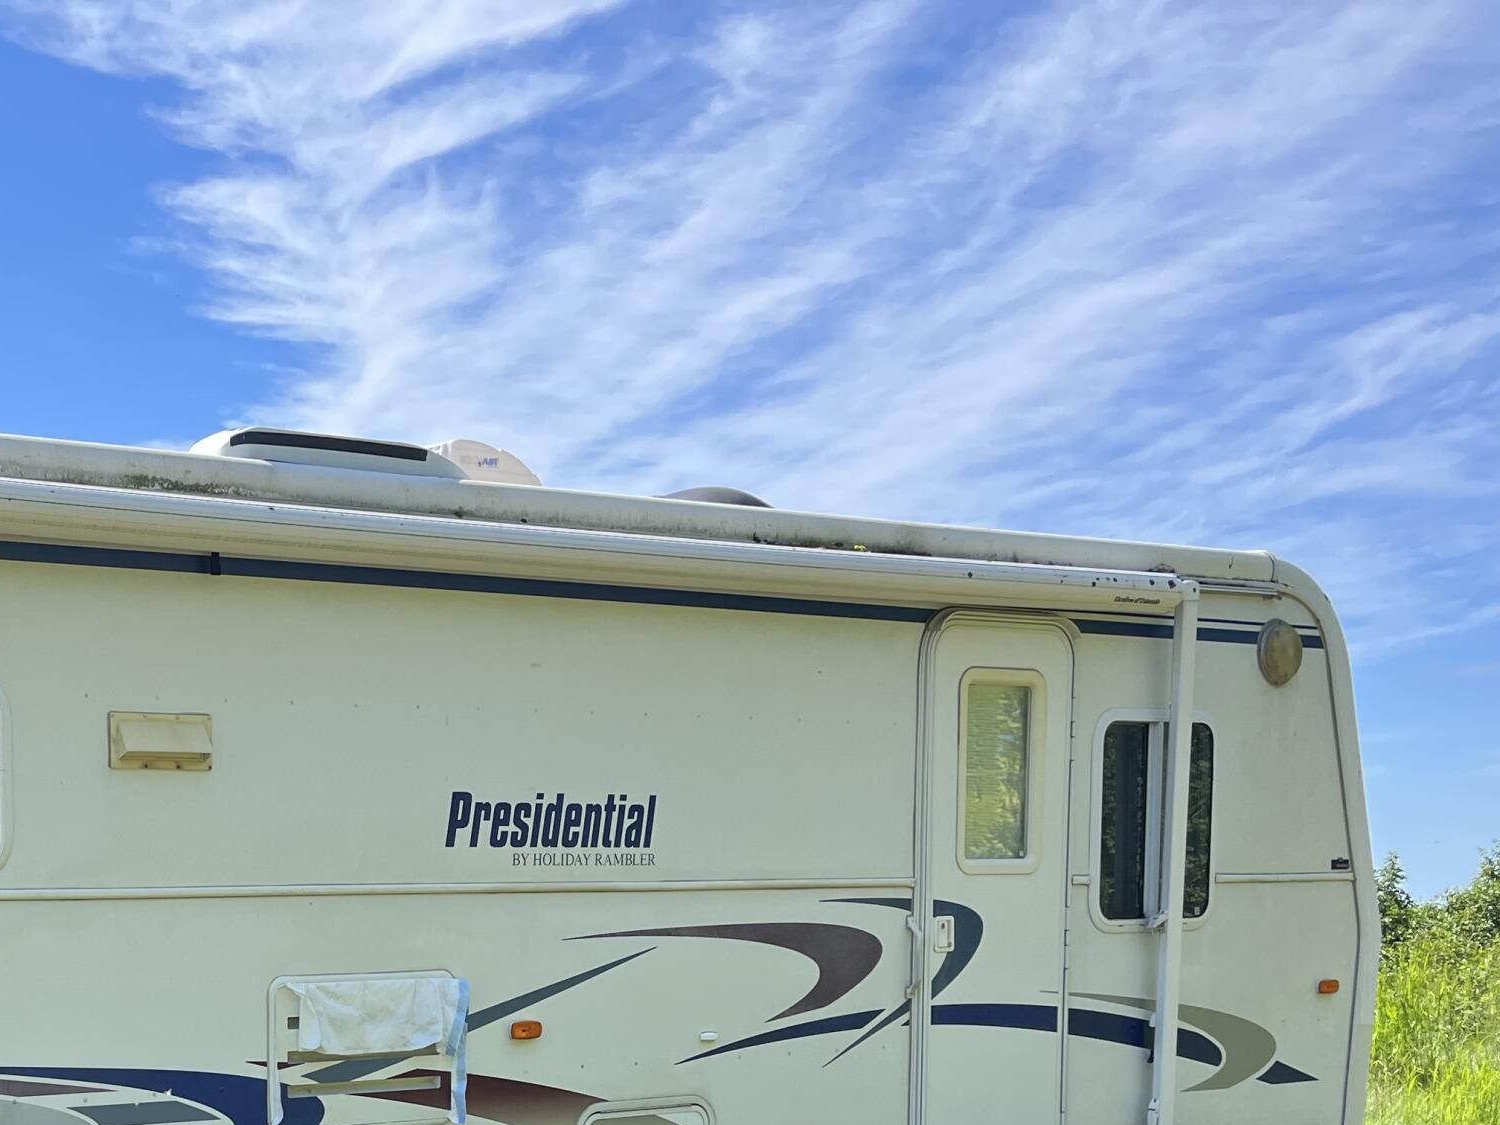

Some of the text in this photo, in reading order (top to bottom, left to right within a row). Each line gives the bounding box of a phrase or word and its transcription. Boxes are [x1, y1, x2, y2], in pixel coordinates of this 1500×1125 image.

[445, 791, 657, 848] Presidential
[512, 853, 656, 866] BY HOLIDAY RAMBLER
